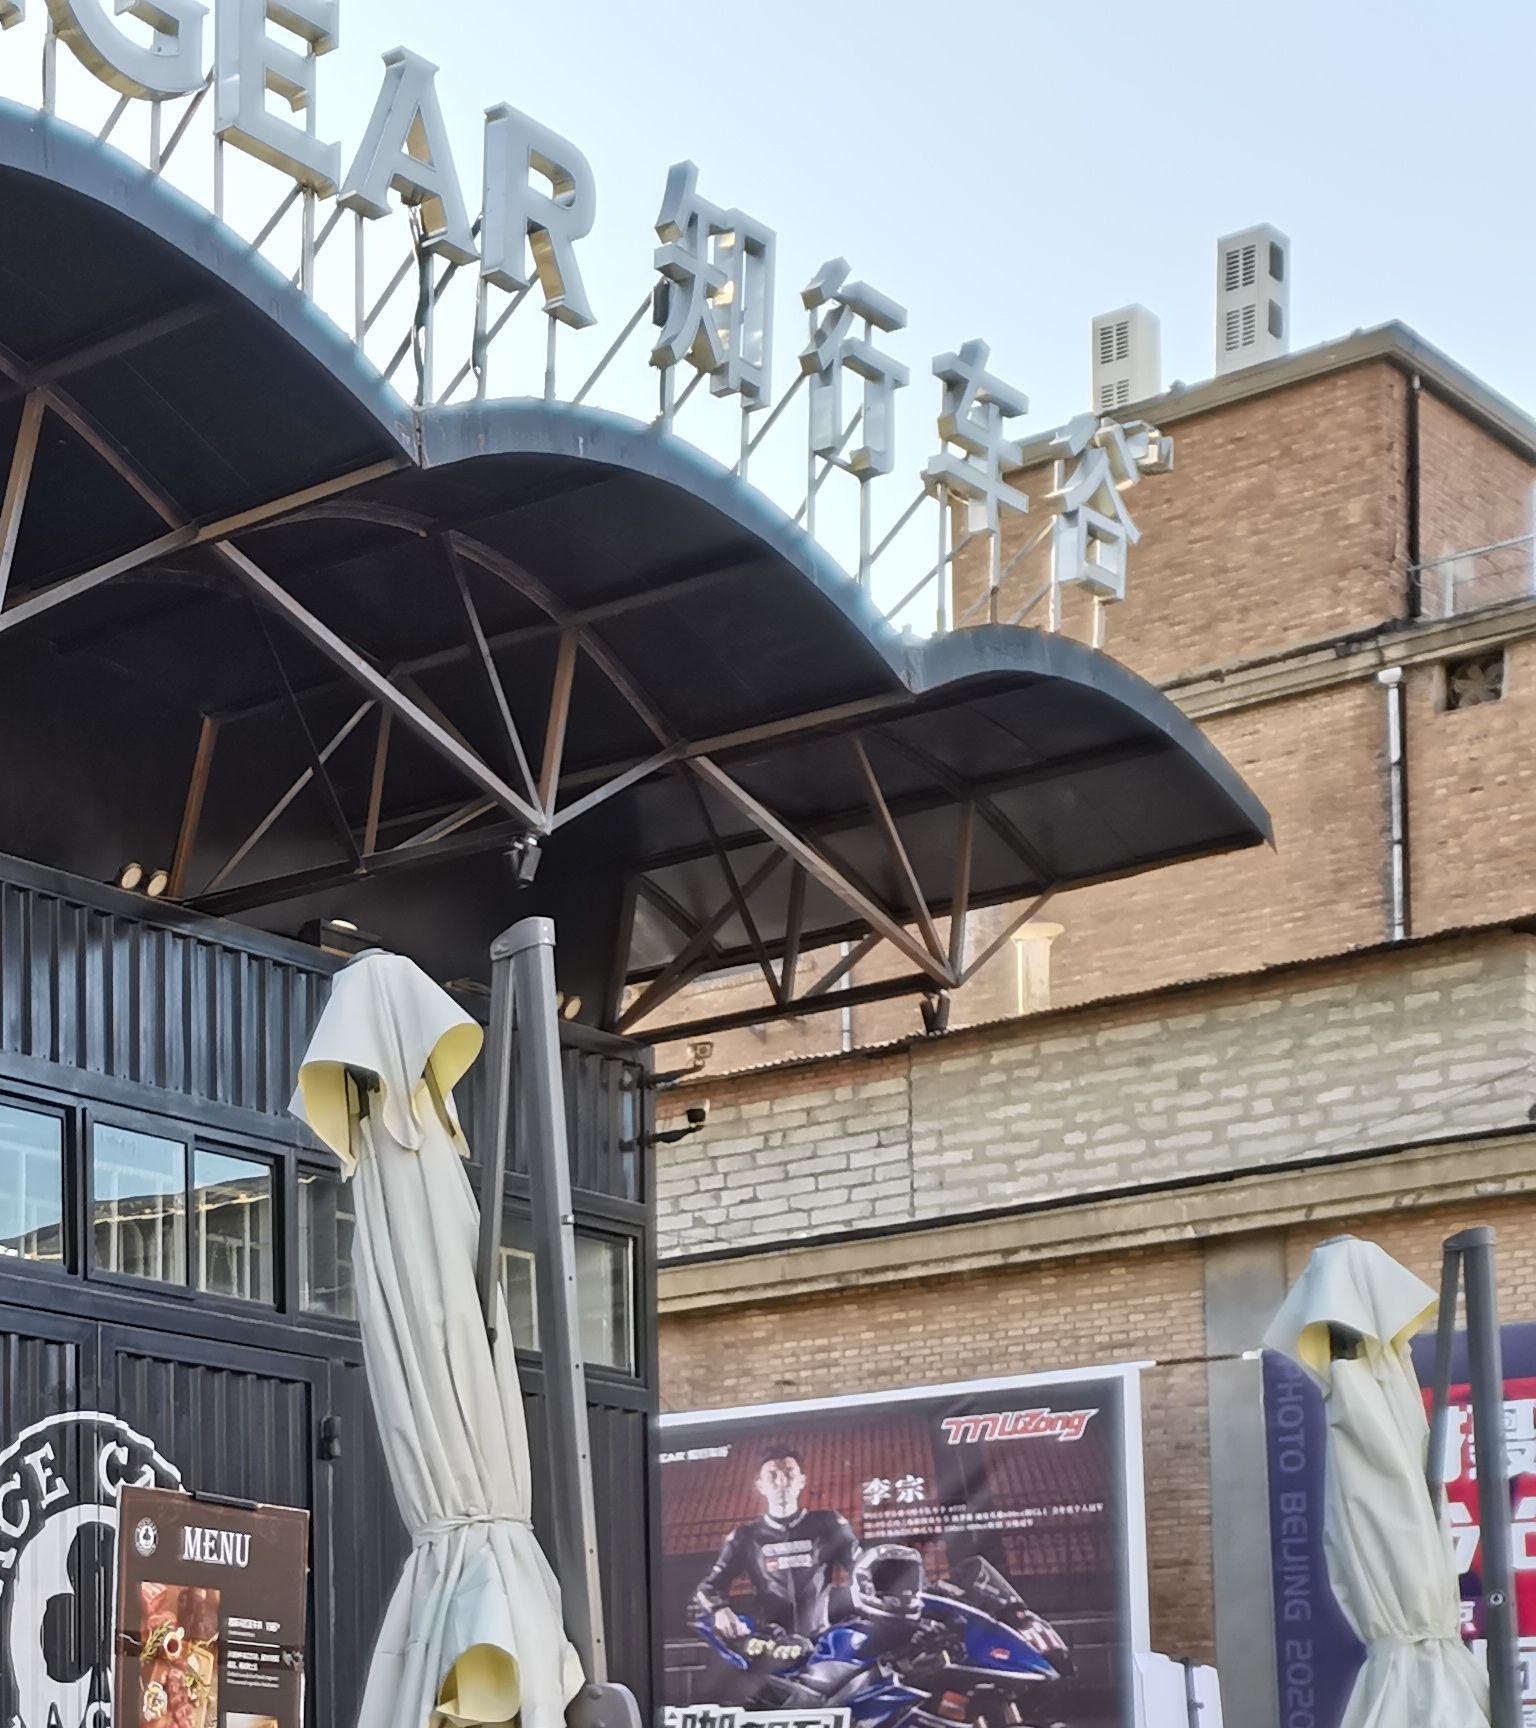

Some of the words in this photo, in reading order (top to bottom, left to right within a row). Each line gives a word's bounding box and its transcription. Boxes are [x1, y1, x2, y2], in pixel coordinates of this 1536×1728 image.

[650, 158, 1175, 604] 知行车谷
[182, 1525, 252, 1568] MENU
